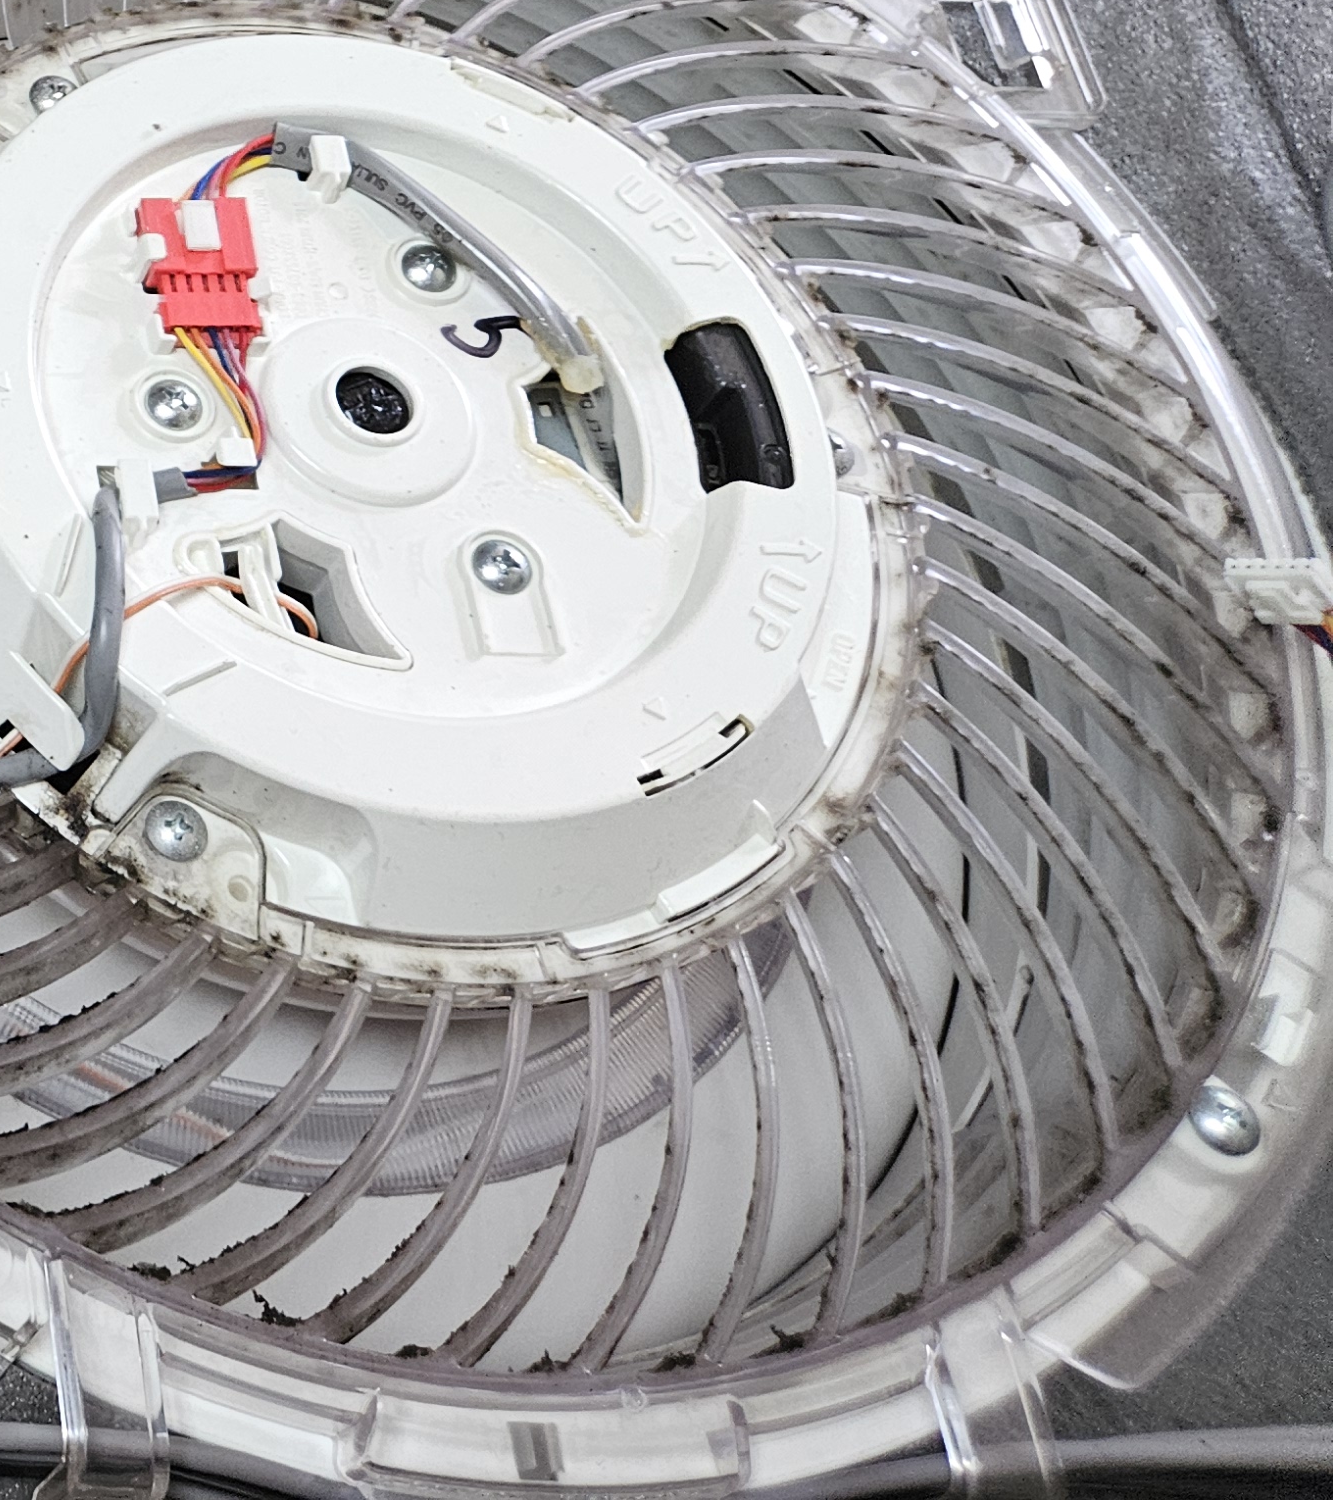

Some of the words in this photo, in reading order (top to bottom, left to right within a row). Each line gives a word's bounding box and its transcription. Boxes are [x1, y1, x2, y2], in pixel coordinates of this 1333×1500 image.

[395, 192, 429, 222] PVC
[614, 173, 700, 242] UP
[748, 564, 811, 653] UP
[821, 629, 857, 693] OPEN
